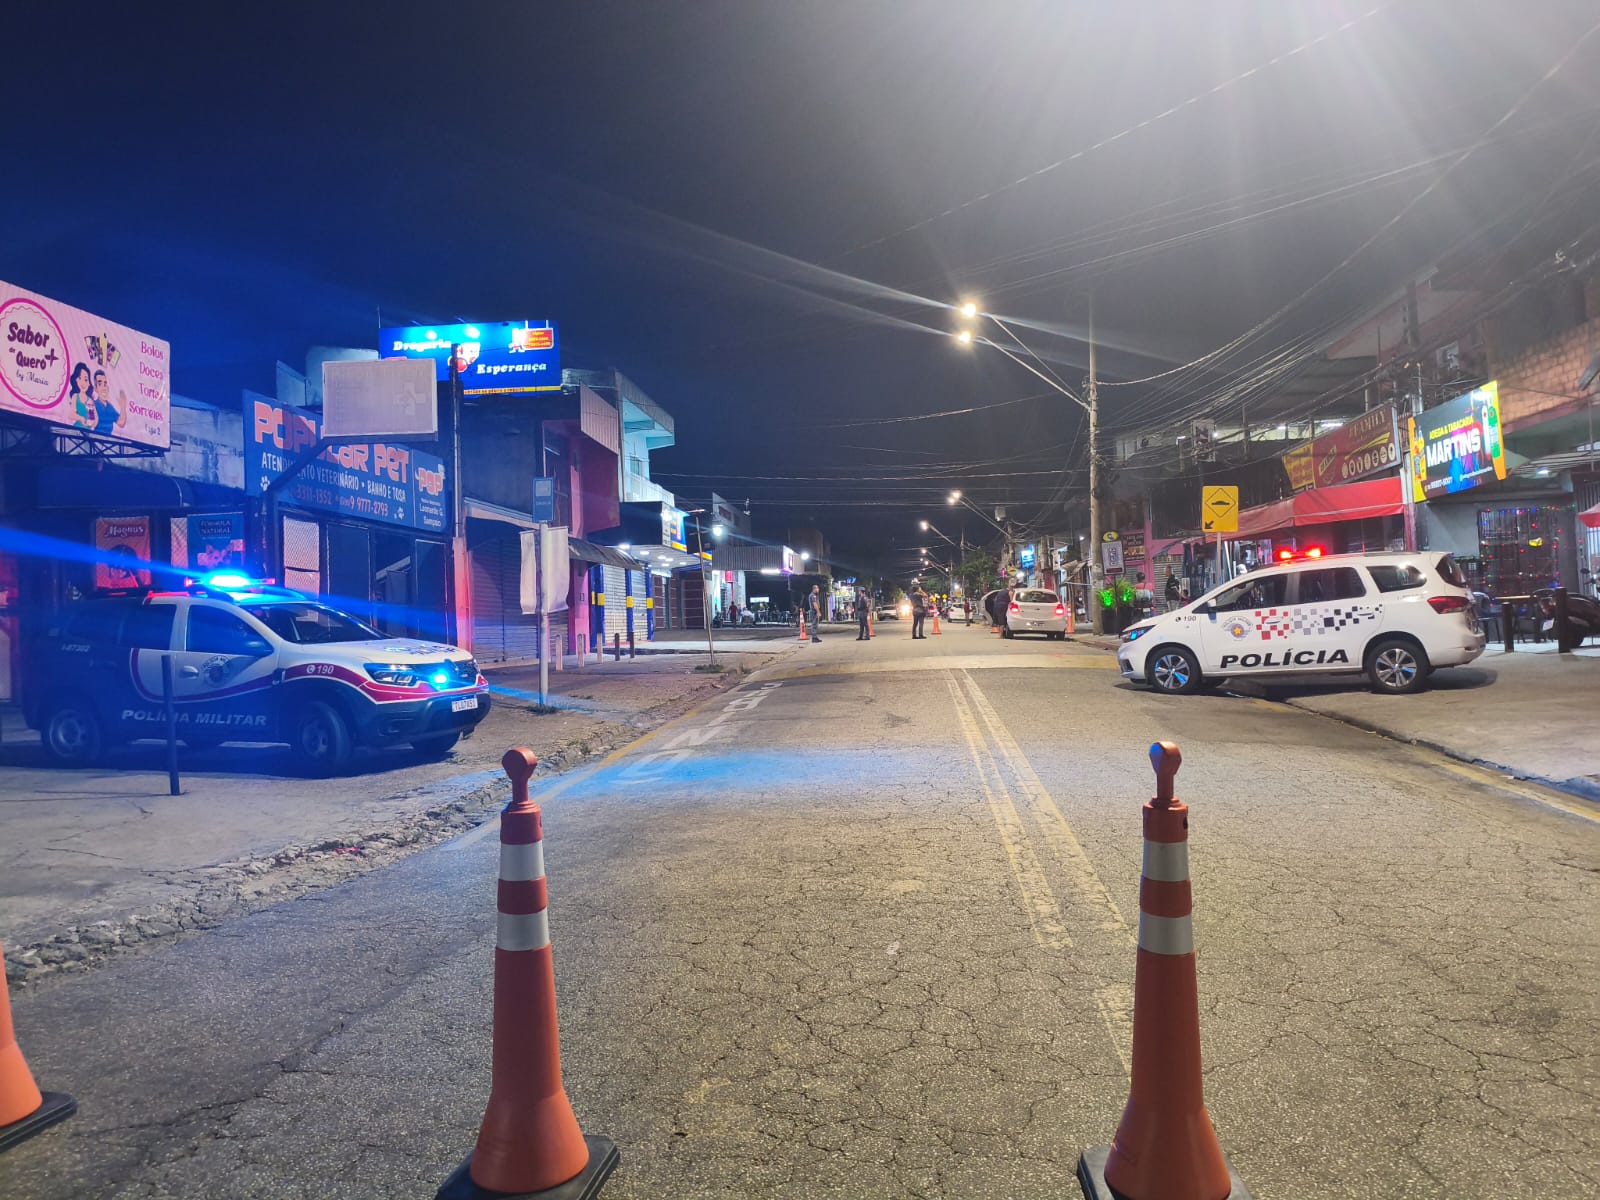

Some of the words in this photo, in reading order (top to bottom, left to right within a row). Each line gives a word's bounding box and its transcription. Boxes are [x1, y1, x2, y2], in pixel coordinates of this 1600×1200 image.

[7, 322, 50, 347] Sabor
[141, 341, 164, 360] Bolos
[393, 339, 451, 352] Drogaria
[139, 361, 164, 379] Doces
[477, 363, 547, 375] Esperança
[27, 372, 48, 385] Maria
[129, 400, 163, 421] Sorvetes
[1426, 428, 1480, 467] MARTINS
[261, 451, 315, 480] ATENDINTO
[367, 480, 387, 498] BANHO
[392, 486, 406, 502] TOSA
[1220, 648, 1350, 669] POLÍCIA
[317, 664, 335, 674] 190
[195, 713, 267, 726] MILITAR
